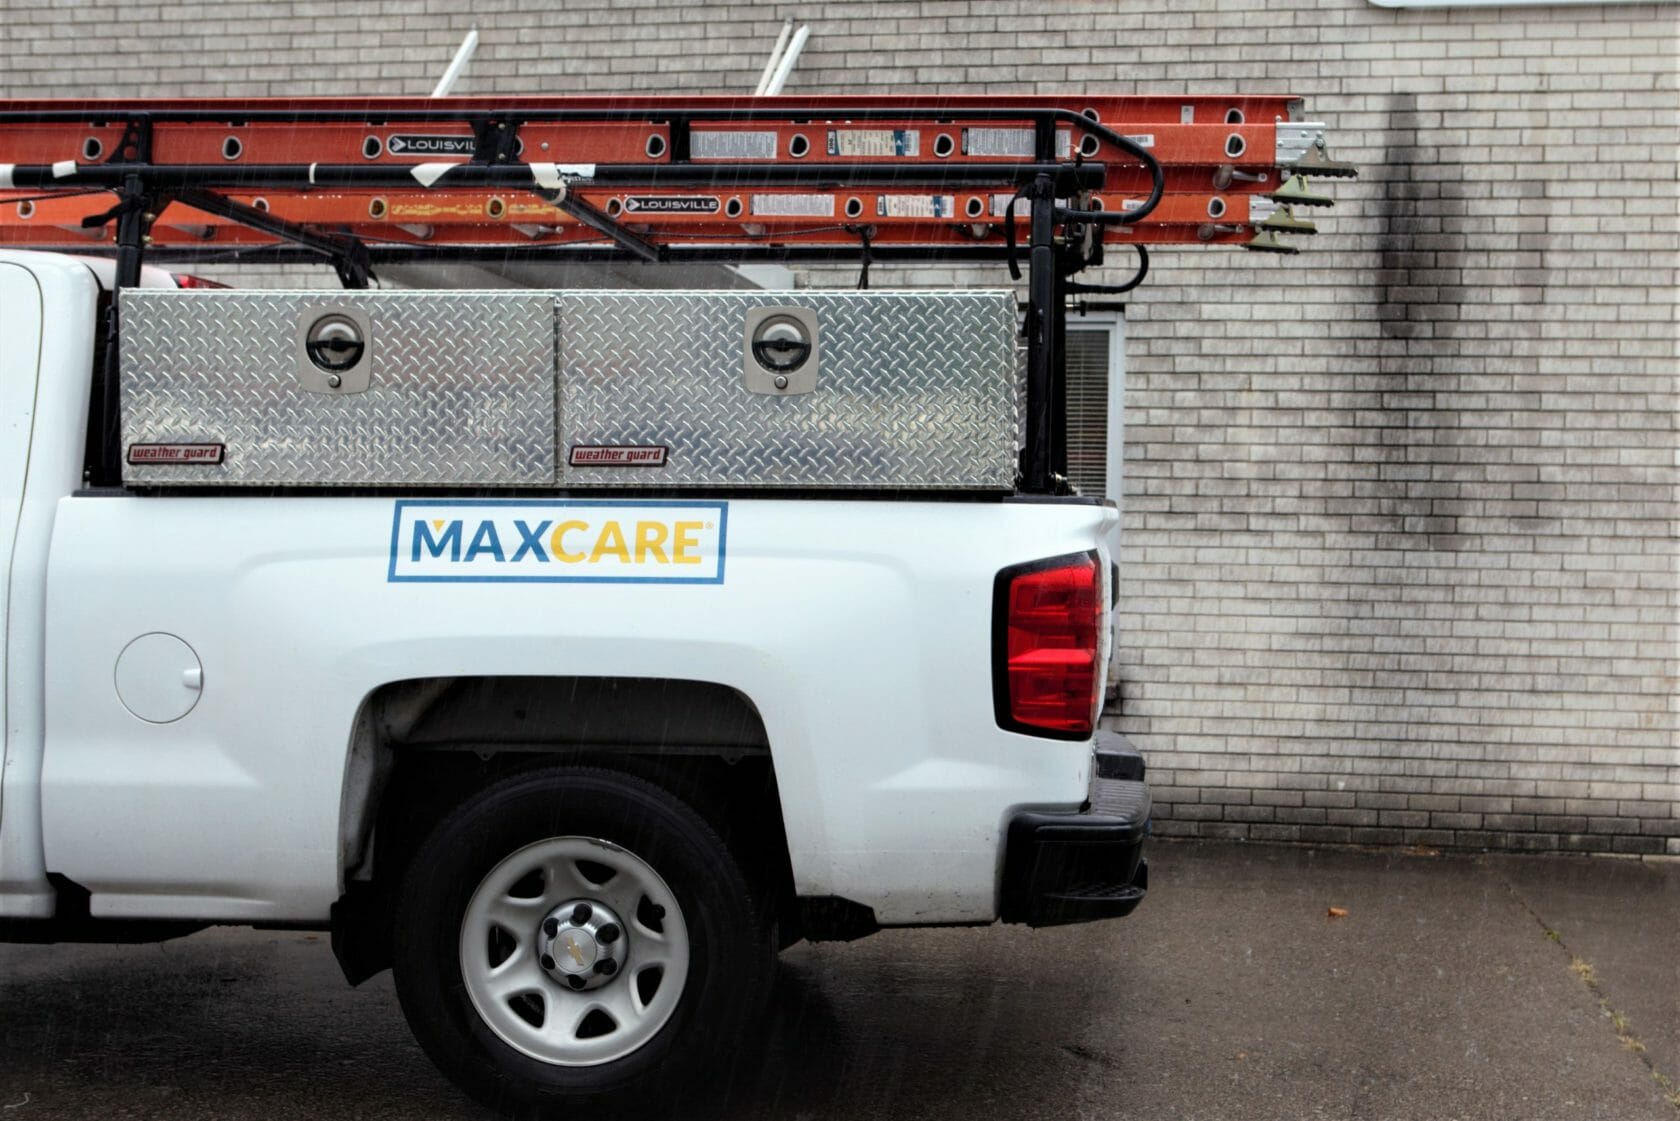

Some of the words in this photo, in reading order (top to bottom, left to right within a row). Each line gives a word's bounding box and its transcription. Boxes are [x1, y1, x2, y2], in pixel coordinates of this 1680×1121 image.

[407, 140, 477, 151] LOUISVIL
[640, 200, 719, 210] LOUISVILLE
[133, 447, 182, 459] weather
[183, 447, 218, 460] guard
[575, 449, 625, 461] weather
[626, 449, 661, 462] guard
